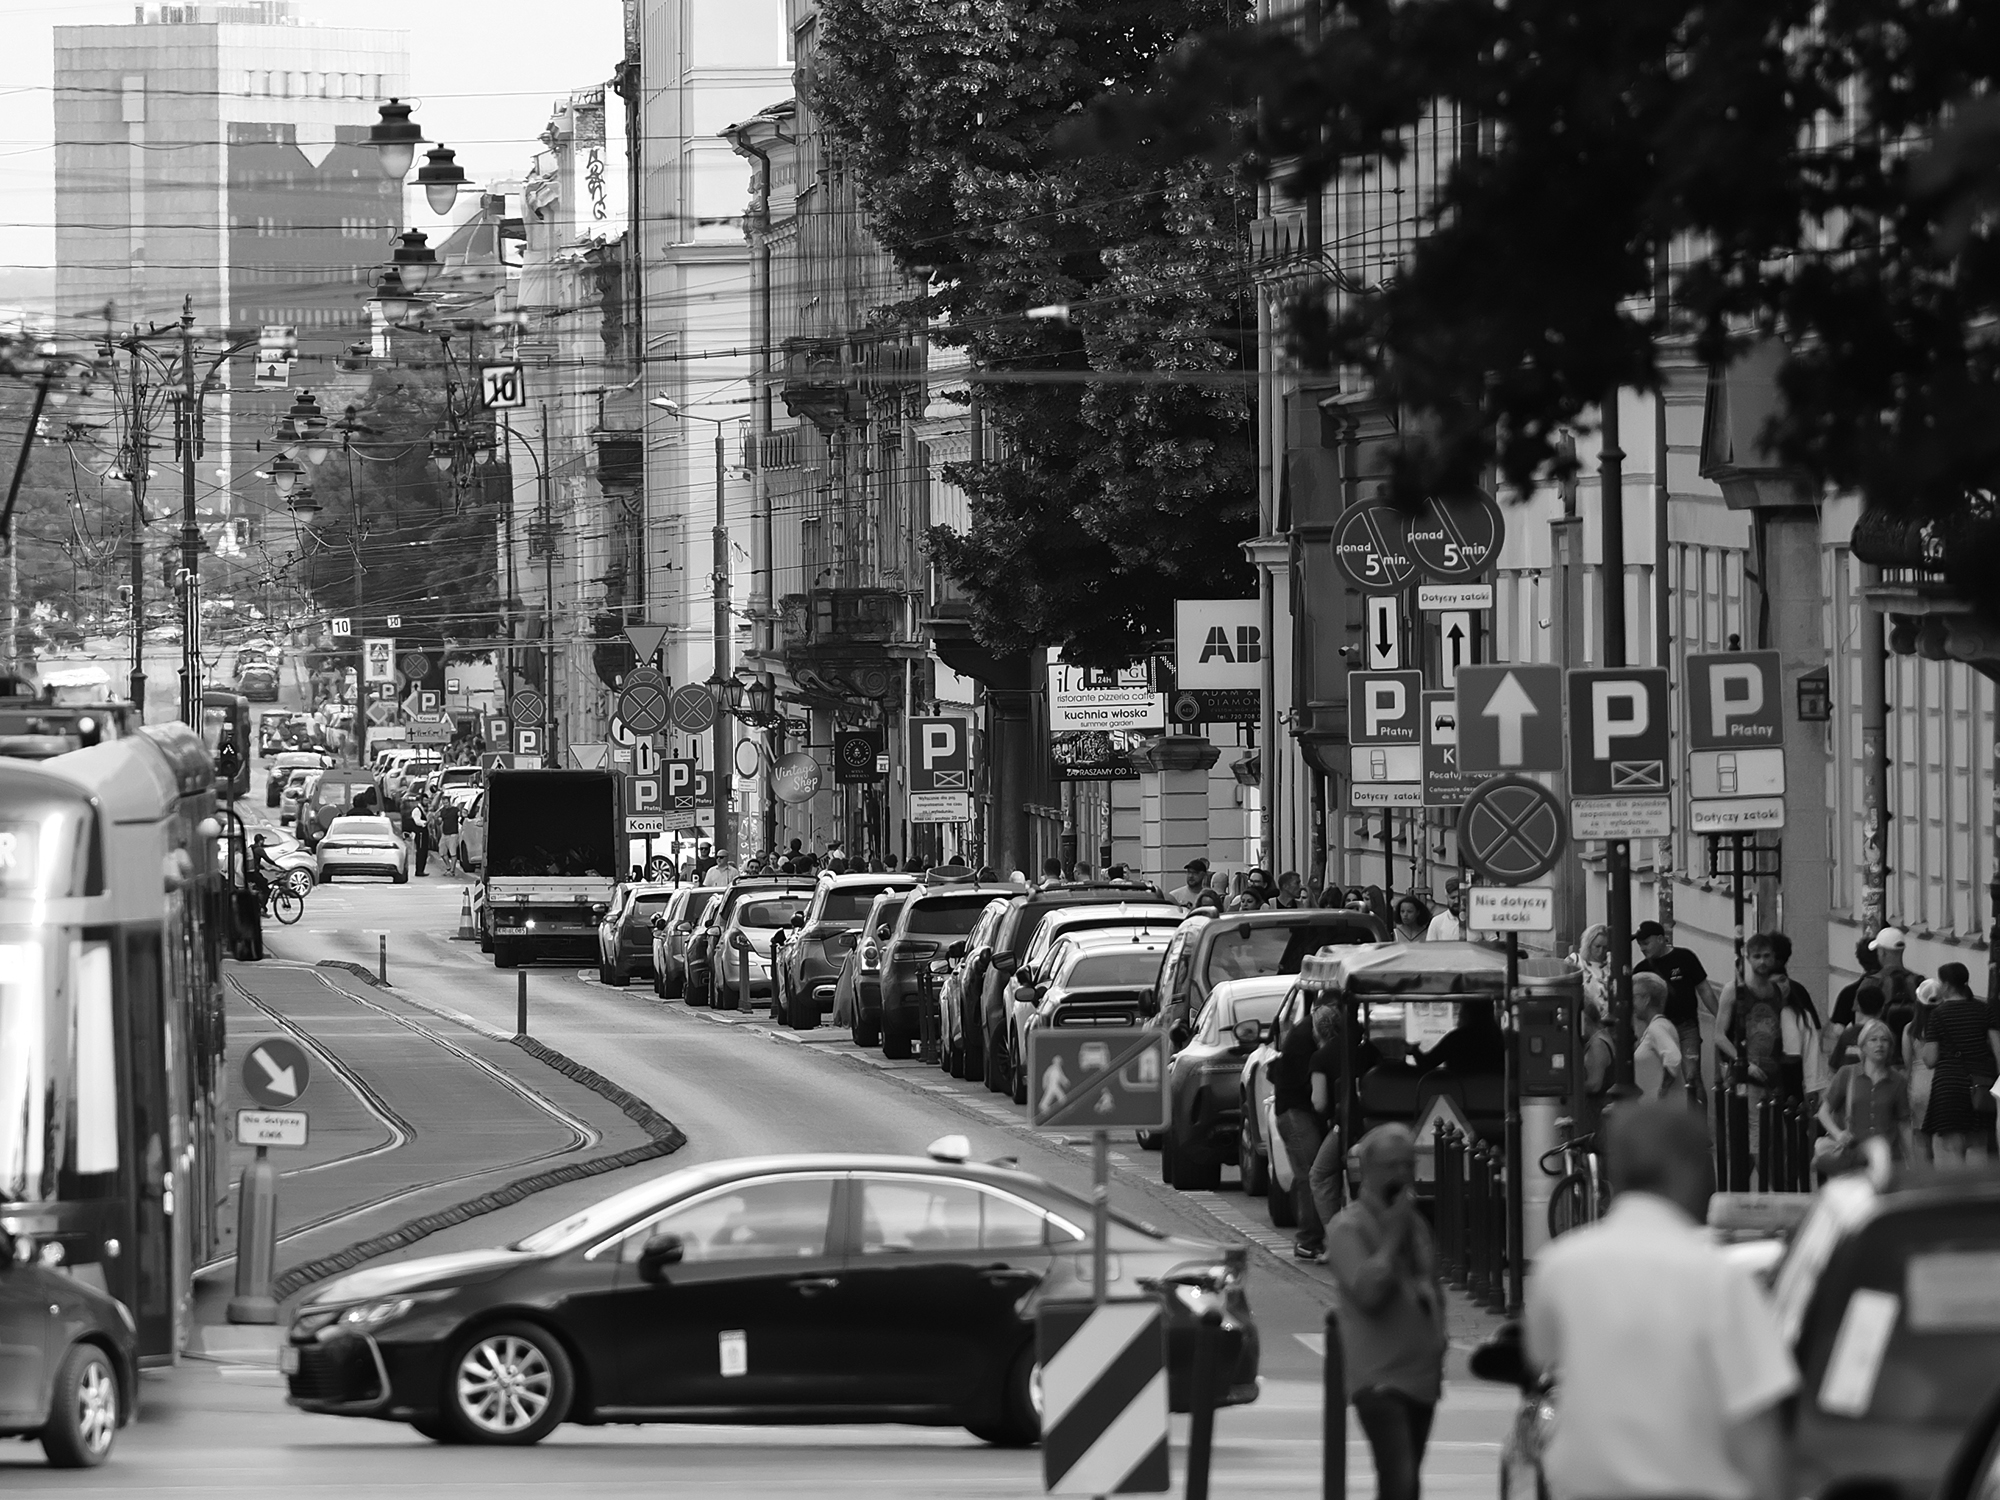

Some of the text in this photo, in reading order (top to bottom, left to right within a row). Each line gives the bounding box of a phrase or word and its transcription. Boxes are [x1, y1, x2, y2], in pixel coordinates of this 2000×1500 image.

[488, 373, 516, 402] 10
[1407, 529, 1444, 542] ponad
[1336, 542, 1371, 555] ponad
[1443, 543, 1458, 566] 5
[1365, 553, 1410, 576] 5 min.
[1421, 591, 1490, 603] Dotyczy zatoki
[335, 620, 349, 633] 10
[1097, 676, 1112, 684] 24H
[382, 683, 395, 699] P
[1057, 693, 1096, 703] ristorante
[1098, 693, 1130, 702] pizzeria
[422, 693, 436, 711] P
[1365, 680, 1406, 736] P
[1709, 663, 1763, 738] P
[1064, 708, 1148, 720] kuchnia włoska
[1592, 681, 1649, 760] P
[491, 720, 507, 741] P
[1109, 720, 1134, 728] garden
[1731, 724, 1774, 737] Płatny
[1380, 727, 1413, 738] Płatny
[520, 730, 536, 753] P
[922, 724, 956, 770] P
[669, 763, 689, 796] P
[775, 764, 816, 781] Vintage
[793, 776, 818, 791] Shop
[635, 780, 657, 811] P
[1354, 792, 1420, 801] Dotyczy zatoki
[1695, 809, 1779, 823] Dotyczy zatoki
[1475, 895, 1548, 909] Nie dotyczy
[1492, 912, 1531, 922] zatoki
